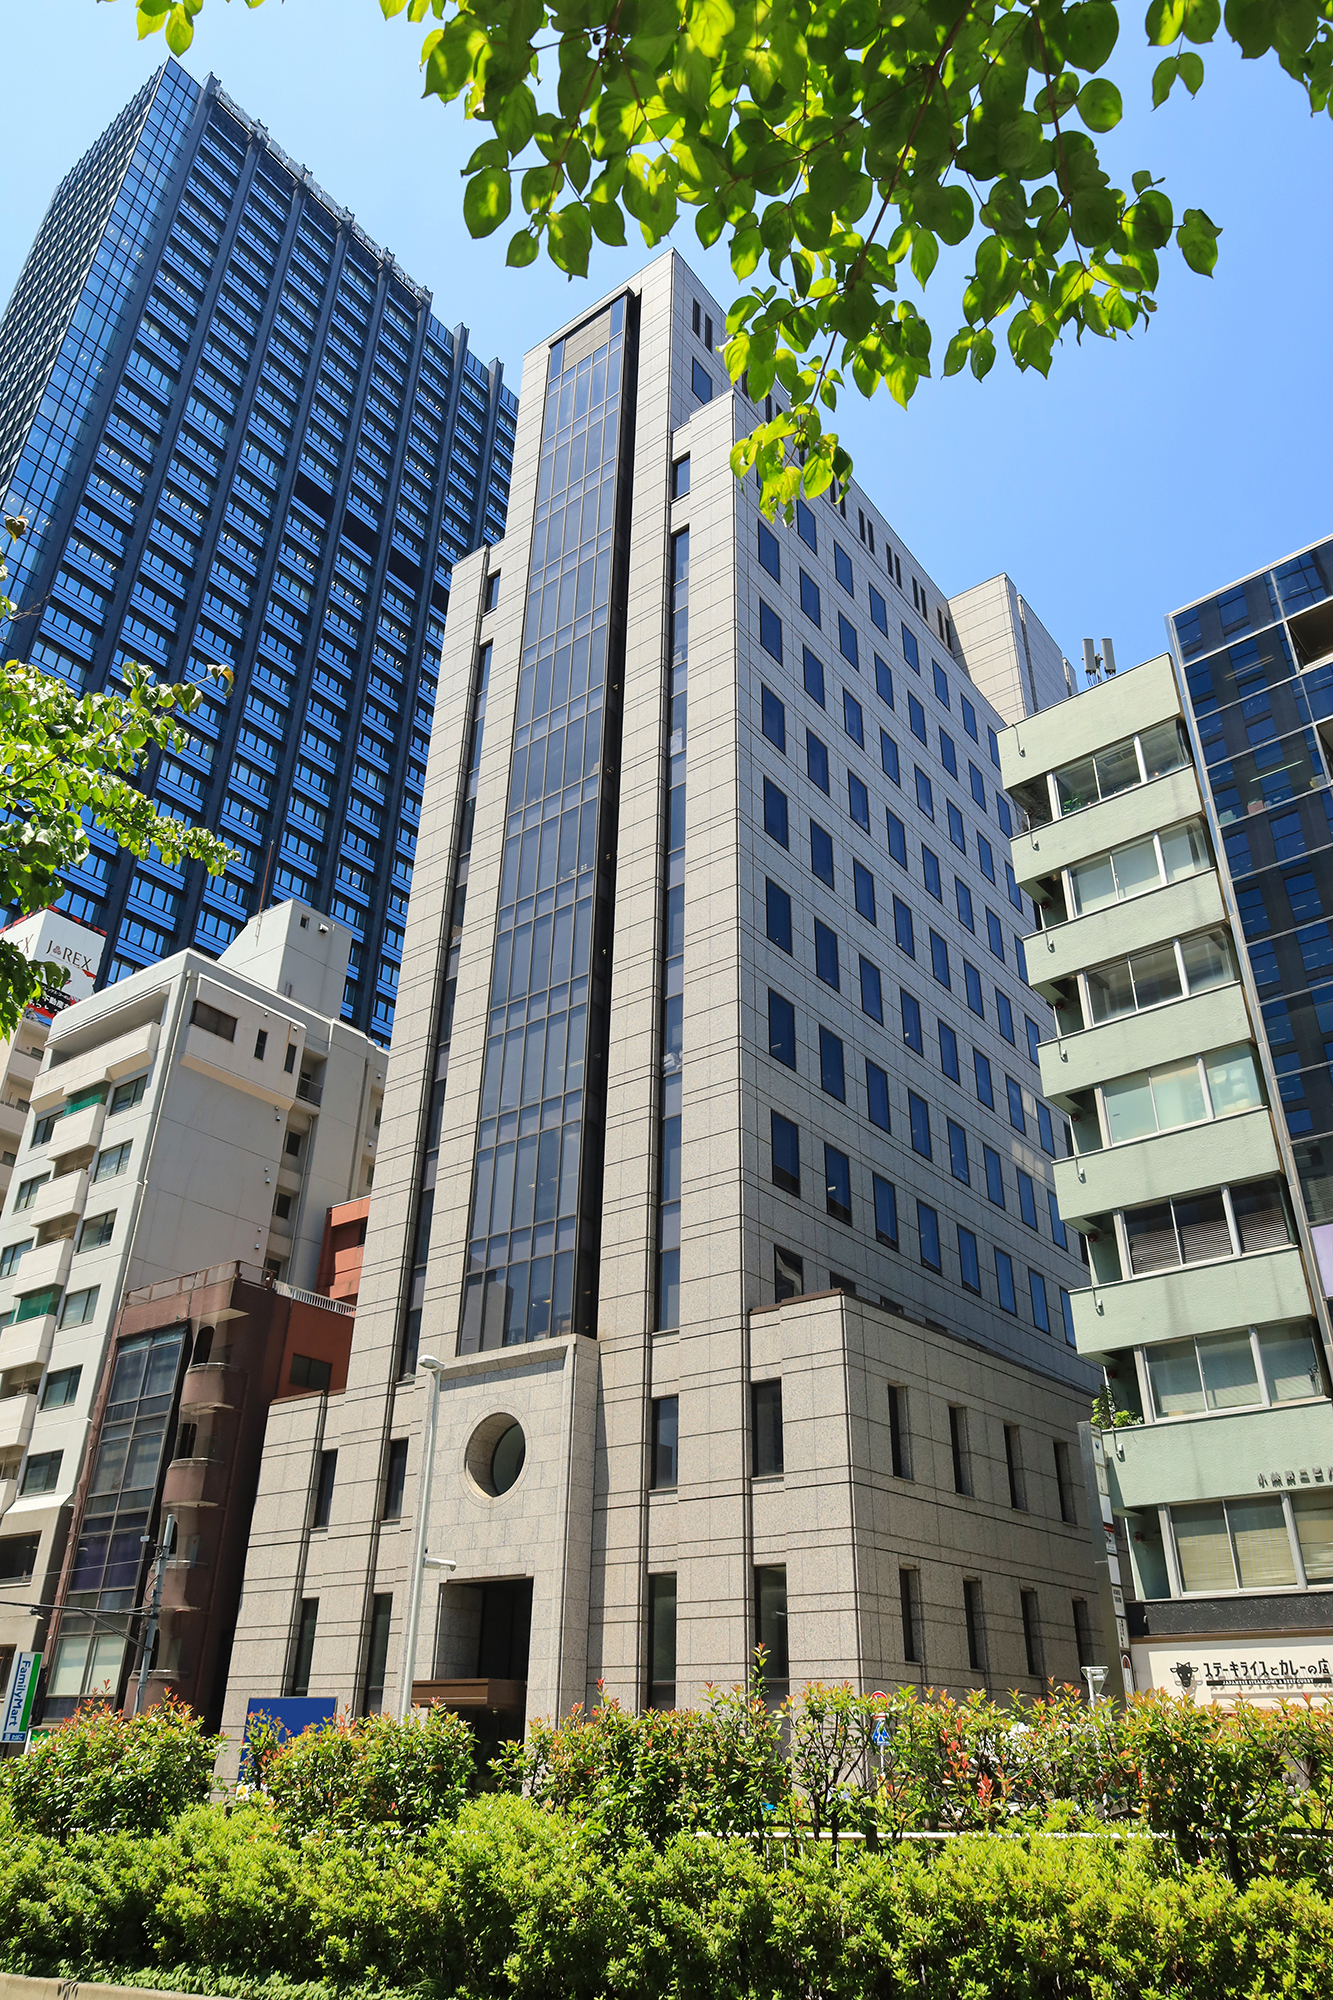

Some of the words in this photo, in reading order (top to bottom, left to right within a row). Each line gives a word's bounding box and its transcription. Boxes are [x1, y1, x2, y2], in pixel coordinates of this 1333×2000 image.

[1203, 1658, 1330, 1677] ステーキライスとカレーの店
[8, 1660, 31, 1727] FamilyMart
